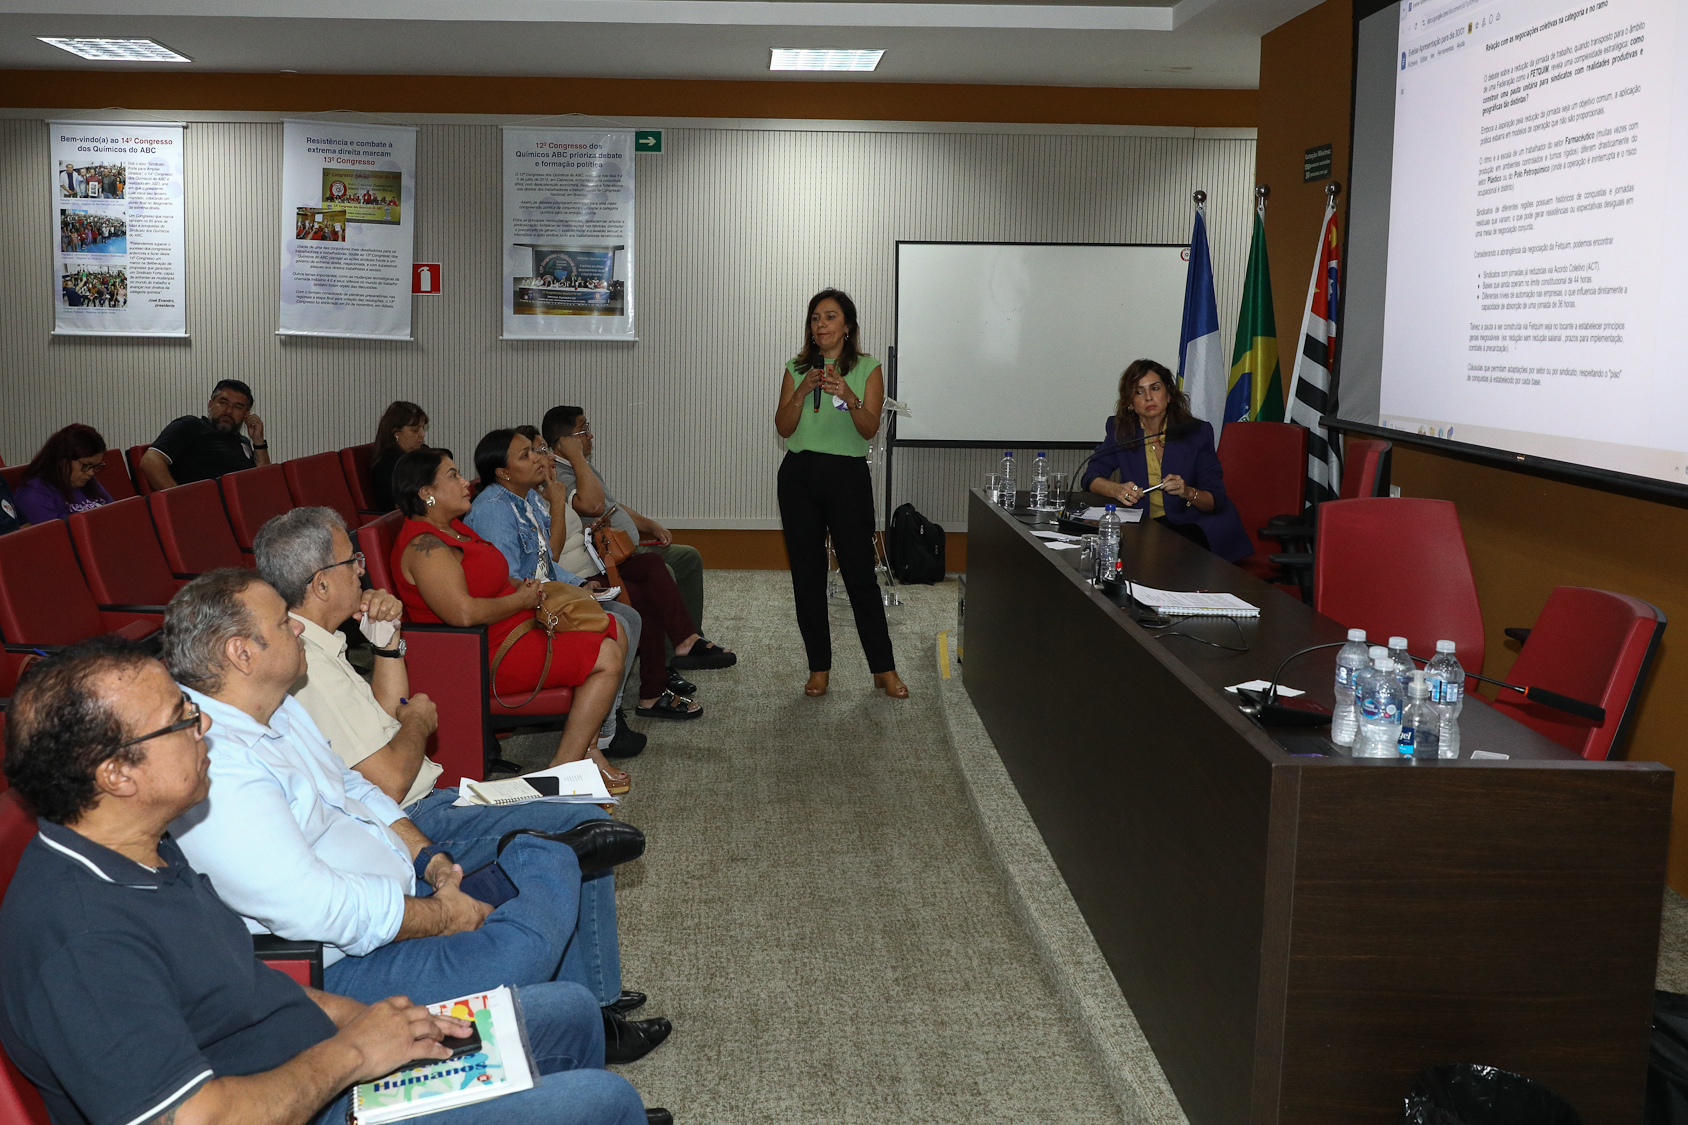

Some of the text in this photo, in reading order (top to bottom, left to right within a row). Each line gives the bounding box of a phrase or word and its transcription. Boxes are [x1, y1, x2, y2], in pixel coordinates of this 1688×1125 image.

[1485, 40, 1500, 52] Relação
[1500, 38, 1509, 47] com
[1514, 26, 1539, 41] negociações
[1539, 19, 1558, 32] coletivas
[1558, 16, 1564, 24] na
[1564, 8, 1585, 22] categoria
[1589, 4, 1596, 13] no
[1596, 0, 1609, 10] ramo
[1483, 85, 1488, 93] de
[1488, 83, 1496, 91] uma
[1496, 76, 1516, 88] Federação
[1516, 74, 1526, 82] como
[1551, 60, 1564, 71] revela
[1564, 58, 1574, 67] uma
[1574, 48, 1603, 64] complexidade
[1630, 35, 1645, 46] como
[1488, 72, 1500, 81] debate
[1500, 68, 1510, 77] sobre
[1514, 61, 1529, 72] redução
[1529, 59, 1535, 67] da
[1535, 54, 1549, 67] jornada
[1550, 52, 1556, 60] de
[1574, 40, 1590, 54] quando
[1590, 33, 1612, 46] transposto
[1613, 29, 1624, 41] para
[1629, 21, 1645, 33] âmbito
[1482, 92, 1499, 104] construir
[1500, 90, 1509, 98] uma
[1510, 86, 1522, 97] pauta
[1523, 80, 1538, 92] unitária
[1539, 78, 1549, 88] para
[1551, 70, 1573, 83] sindicatos
[1574, 66, 1584, 76] com
[1586, 58, 1610, 72] realidades
[1612, 50, 1638, 66] produtivas
[1481, 125, 1494, 134] Embora
[1498, 119, 1515, 130] aspiração
[1516, 116, 1524, 127] pela
[1524, 112, 1539, 122] redução
[1540, 110, 1546, 118] da
[1546, 106, 1561, 118] jornada
[1562, 103, 1570, 113] seja
[1579, 97, 1595, 108] objetivo
[1620, 84, 1641, 98] aplicação
[1482, 103, 1503, 116] geográficas
[60, 136, 108, 145] Bem-vindo(a)
[134, 138, 173, 146] Congresso
[306, 137, 348, 146] Resistência
[356, 140, 386, 148] combate
[336, 157, 375, 166] Congresso
[1487, 174, 1502, 184] Plástico
[1508, 172, 1513, 180] do
[1513, 170, 1523, 179] Polo
[1523, 165, 1550, 177] Petroquímico
[1567, 157, 1586, 170] operação
[1591, 152, 1616, 163] ininterrupta
[1626, 148, 1638, 157] risco
[374, 1062, 488, 1092] Humanos
